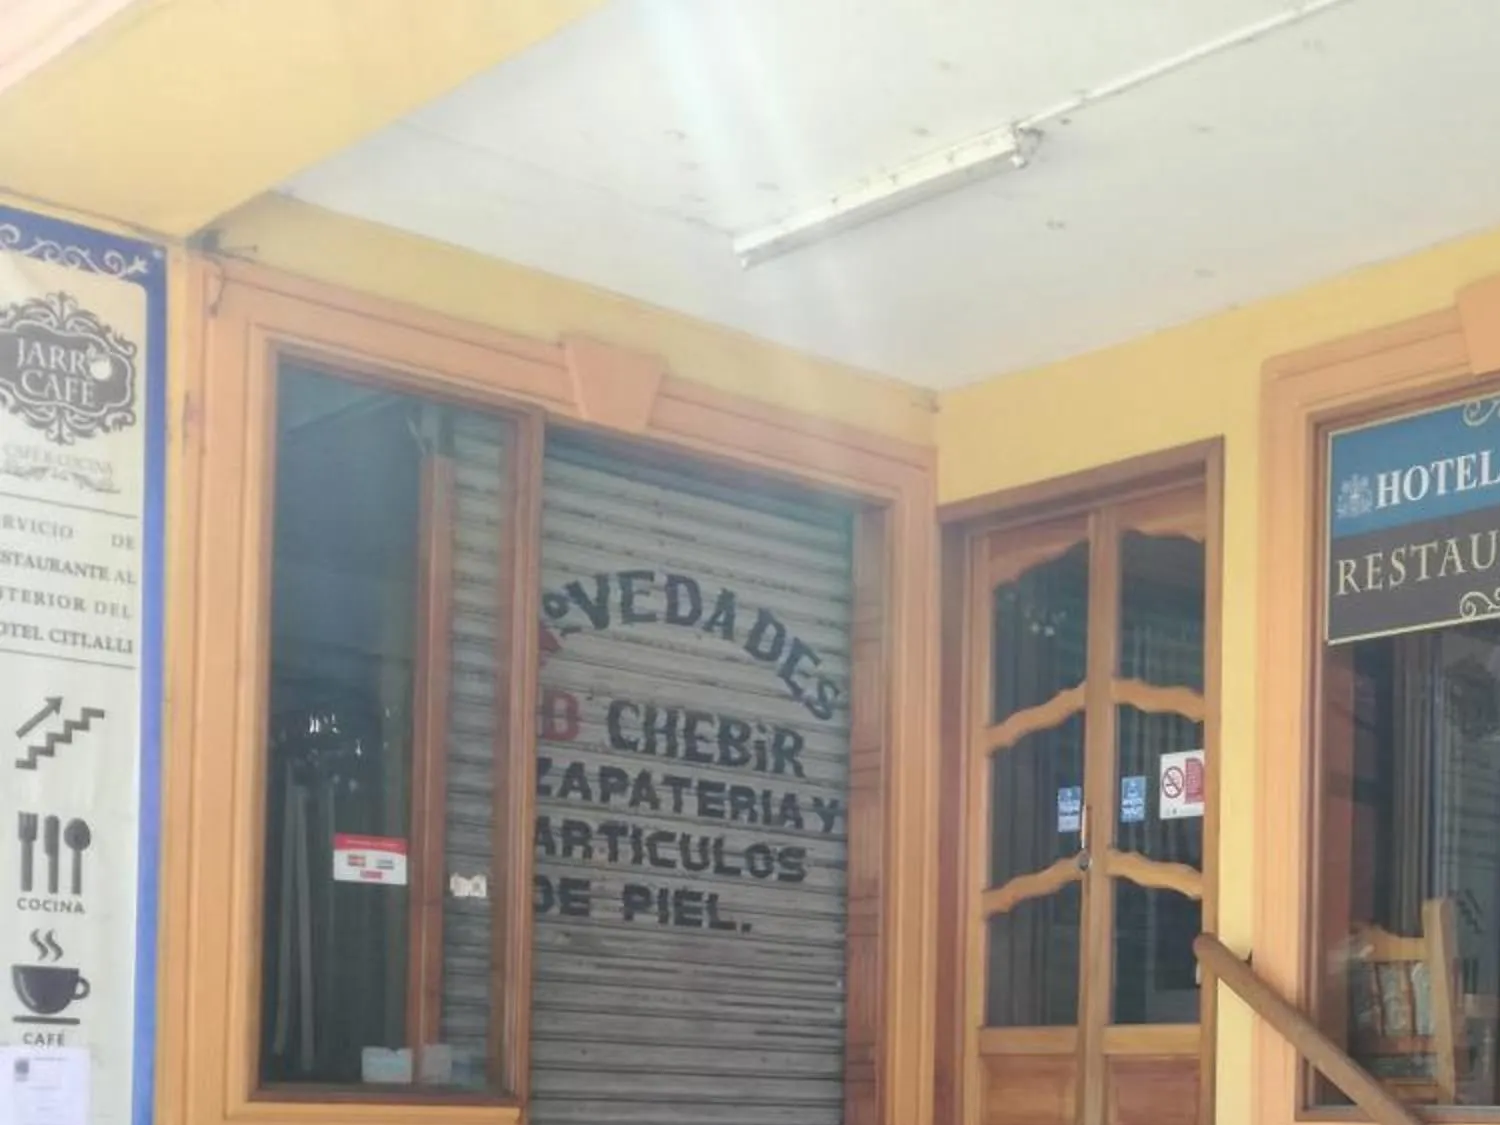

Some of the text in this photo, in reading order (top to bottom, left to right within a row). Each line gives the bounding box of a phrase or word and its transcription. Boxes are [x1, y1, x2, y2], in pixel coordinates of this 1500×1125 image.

[111, 533, 136, 550] DE
[0, 549, 137, 585] STAURANTE AL
[95, 600, 133, 619] DEL
[49, 627, 133, 654] CITLALLI
[812, 797, 842, 834] Y
[534, 815, 808, 883] ARTICULOS
[17, 897, 85, 914] COCINA
[534, 874, 754, 935] DE PIEL.
